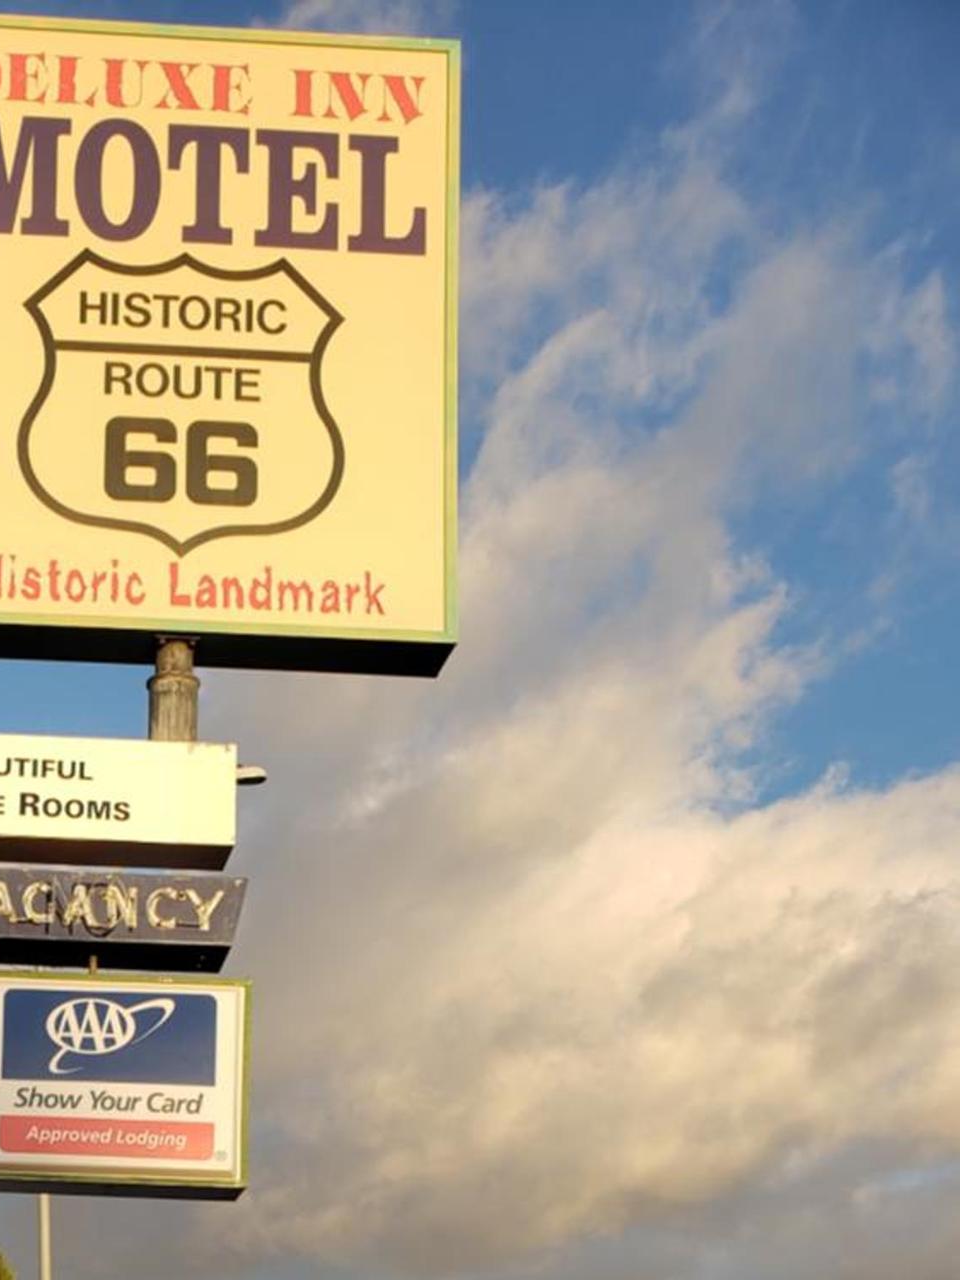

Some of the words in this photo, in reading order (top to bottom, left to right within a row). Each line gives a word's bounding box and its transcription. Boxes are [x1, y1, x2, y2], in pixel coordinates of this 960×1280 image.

[291, 68, 426, 125] INN
[78, 290, 288, 335] HISTORIC
[103, 361, 262, 402] ROUTE
[103, 416, 259, 508] 66
[169, 562, 386, 617] Landmark
[18, 792, 131, 822] ROOMS
[58, 1002, 132, 1053] AAA
[14, 1086, 81, 1111] Show
[90, 1089, 141, 1112] Your
[146, 1092, 203, 1115] Card
[25, 1125, 112, 1149] Approved
[115, 1130, 187, 1152] Lodging
